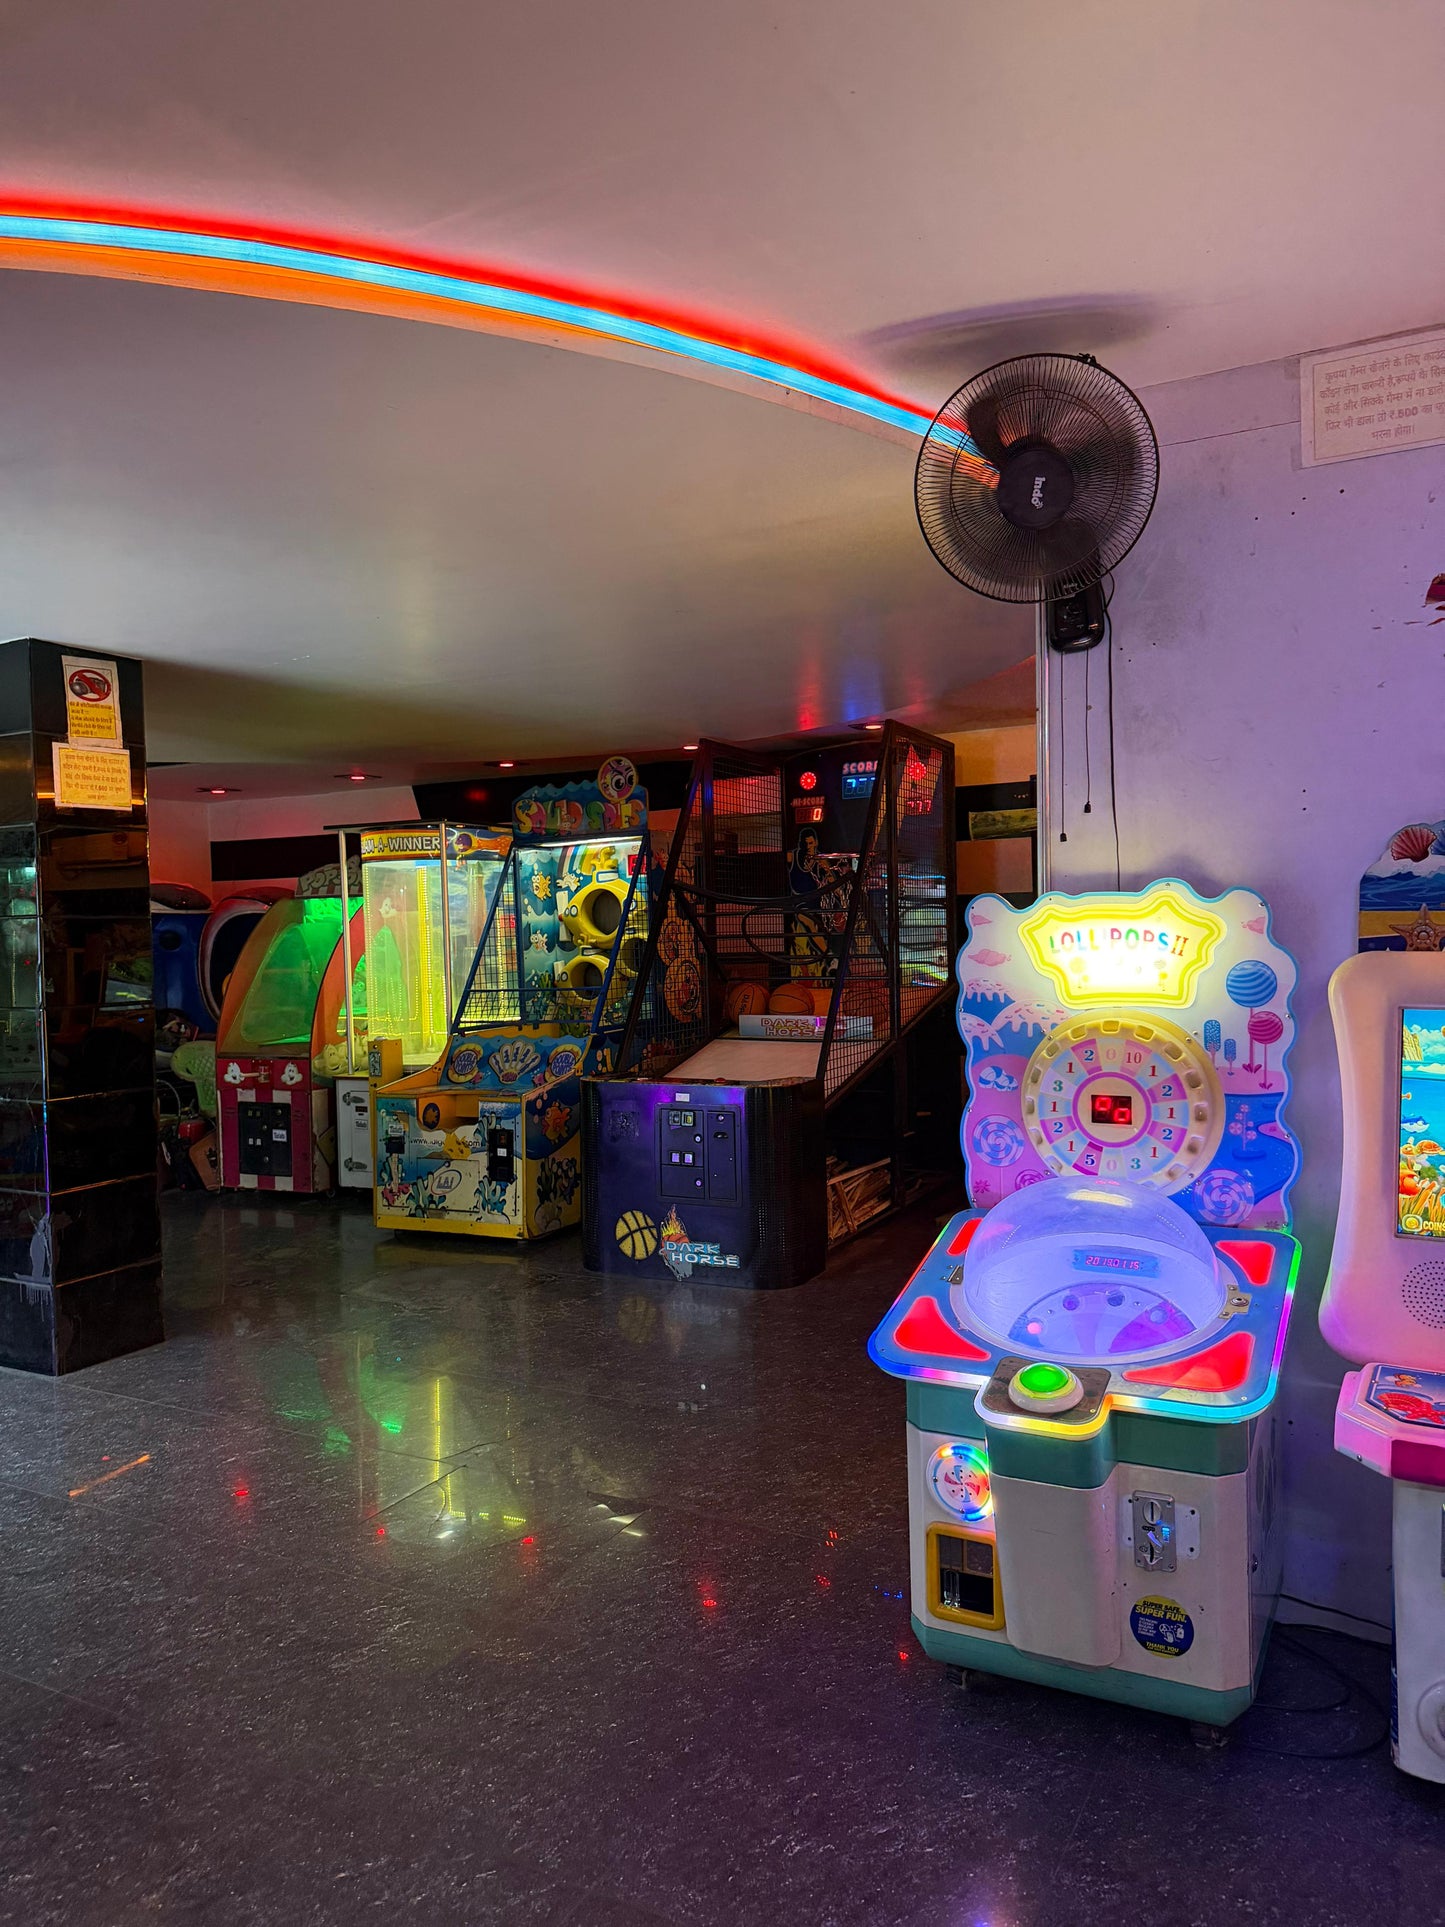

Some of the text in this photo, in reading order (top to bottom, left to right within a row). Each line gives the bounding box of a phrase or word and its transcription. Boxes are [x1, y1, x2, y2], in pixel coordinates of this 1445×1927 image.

[1393, 356, 1402, 367] के
[1084, 1049, 1094, 1061] 2
[1126, 1052, 1142, 1064] 10
[1066, 1062, 1075, 1074] 1
[1149, 1065, 1158, 1077] 1
[1053, 1080, 1063, 1092] 3
[1162, 1085, 1172, 1097] 2
[1050, 1101, 1058, 1112] 1
[1167, 1107, 1176, 1119] 1
[1053, 1121, 1063, 1133] 2
[1162, 1128, 1173, 1140] 2
[1068, 1140, 1076, 1152] 1
[1150, 1146, 1159, 1158] 1
[1085, 1154, 1095, 1166] 5
[1130, 1157, 1141, 1170] 3
[666, 1241, 721, 1254] DARK
[671, 1252, 738, 1267] HORSE
[1136, 1606, 1164, 1618] SUPER
